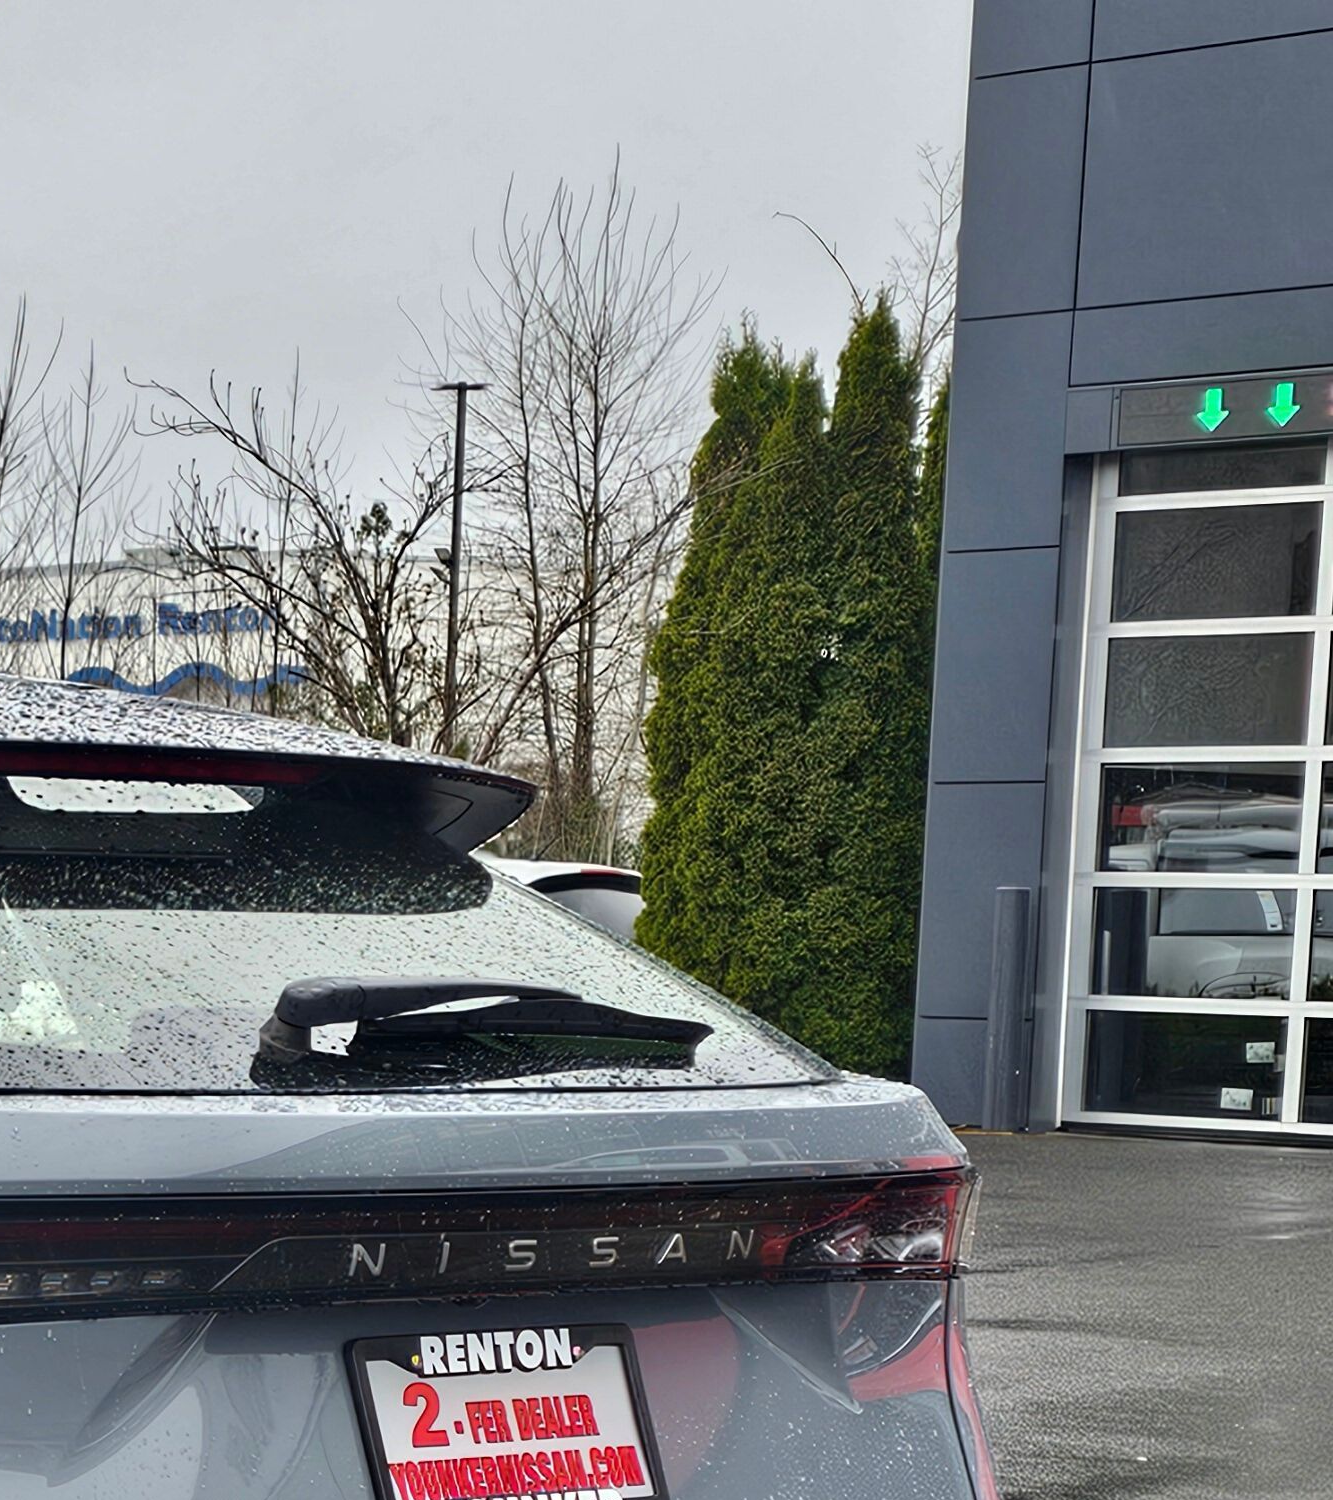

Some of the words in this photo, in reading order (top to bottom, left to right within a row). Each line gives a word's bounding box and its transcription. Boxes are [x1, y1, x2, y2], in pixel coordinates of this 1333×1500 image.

[348, 1228, 755, 1277] NISSAN
[420, 1328, 574, 1375] RENTON
[512, 1394, 601, 1441] DEALER
